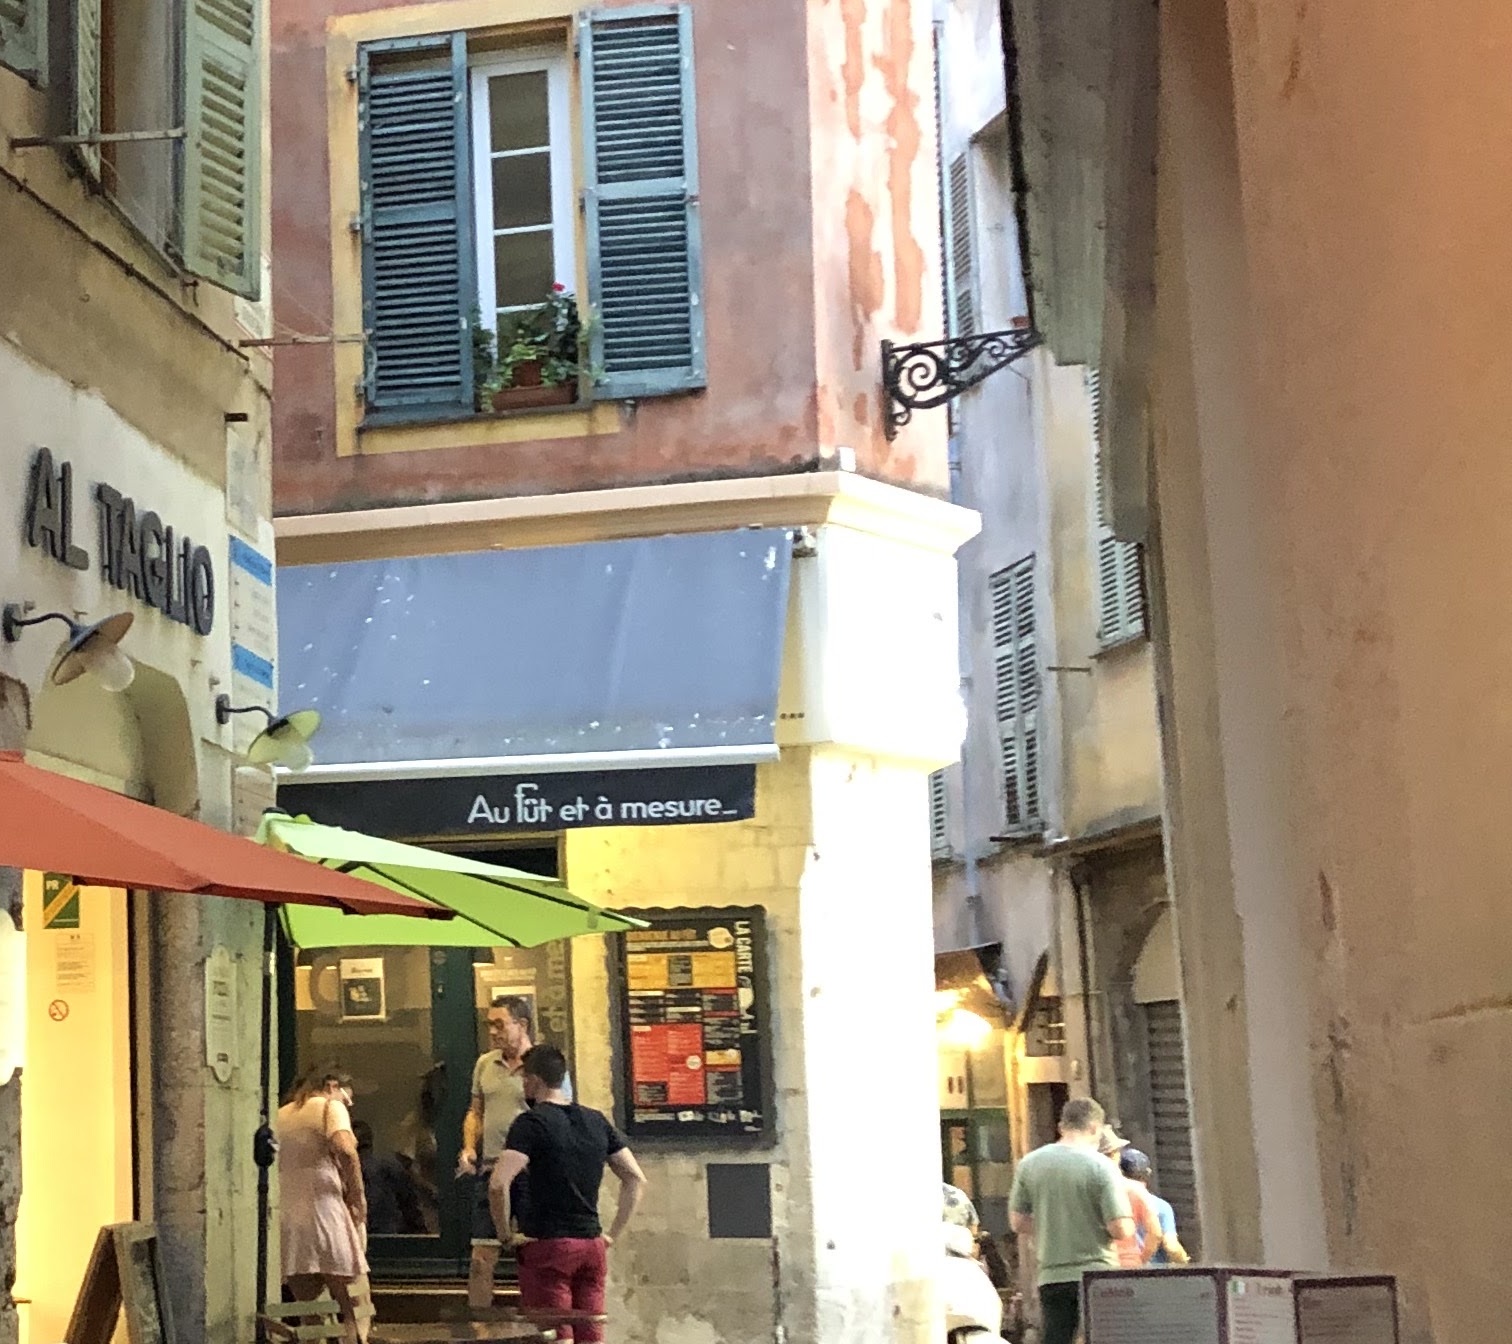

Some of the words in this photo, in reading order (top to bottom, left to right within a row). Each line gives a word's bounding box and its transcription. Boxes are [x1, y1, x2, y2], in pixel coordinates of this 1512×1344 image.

[26, 446, 89, 571] AL
[95, 482, 215, 636] TAGLIO
[467, 795, 510, 824] Au
[559, 796, 590, 821] et
[595, 795, 614, 820] à
[734, 920, 752, 935] LA
[736, 937, 754, 973] CARTE
